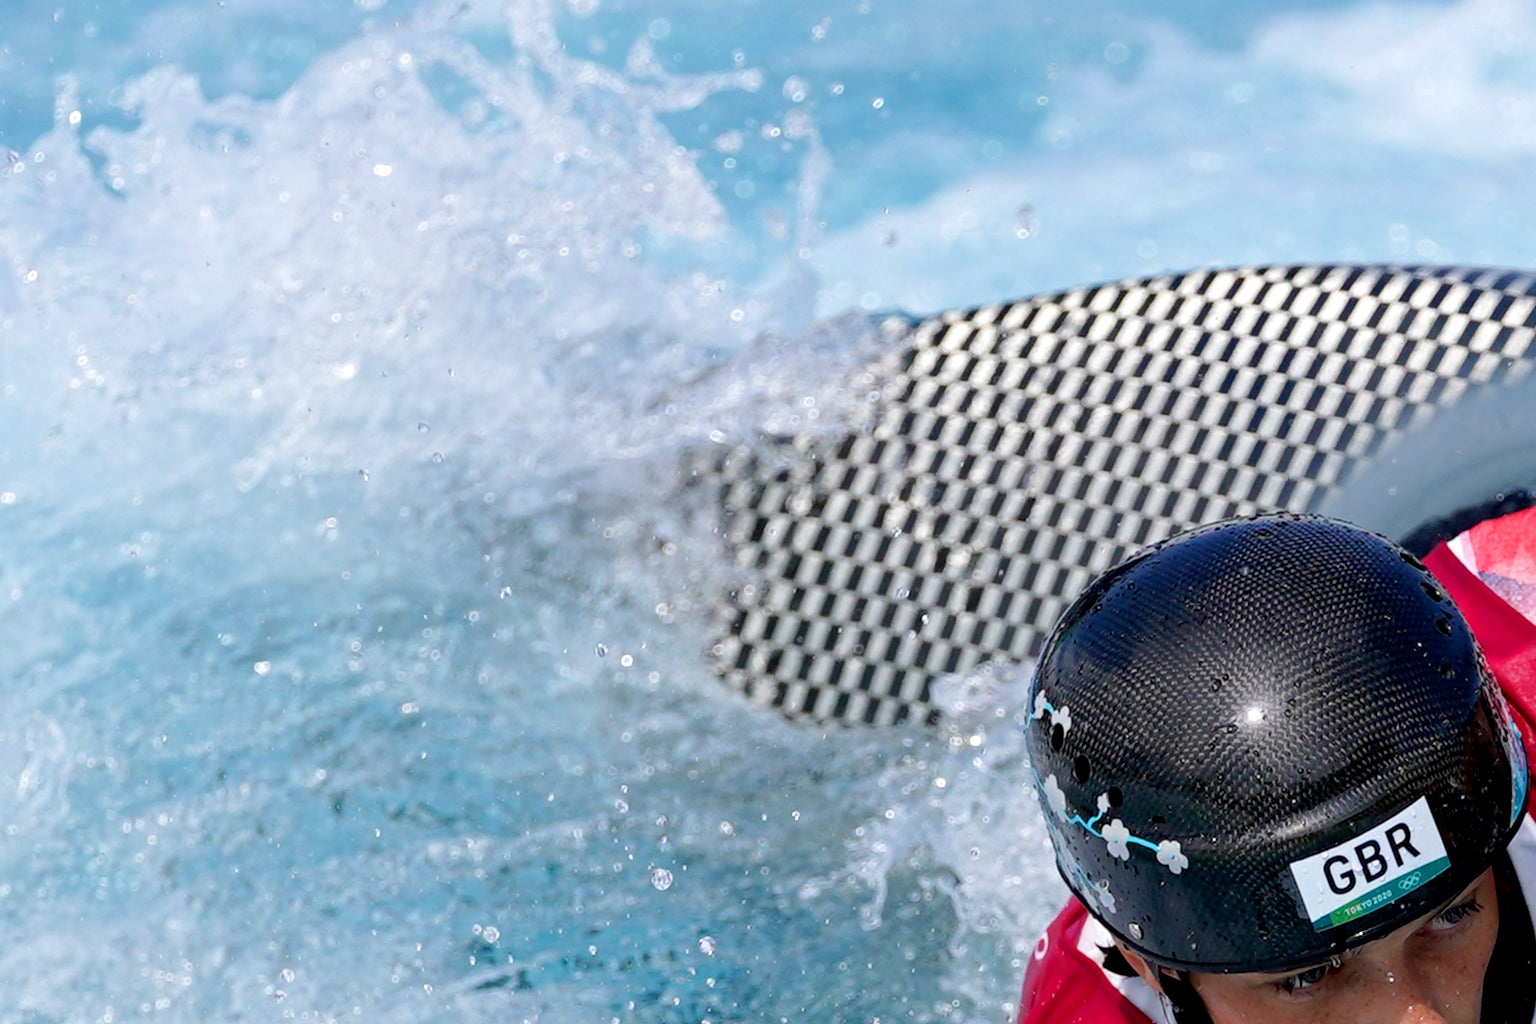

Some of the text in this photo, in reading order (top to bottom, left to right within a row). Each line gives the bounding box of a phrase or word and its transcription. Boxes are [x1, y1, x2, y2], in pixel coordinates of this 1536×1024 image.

[1323, 822, 1421, 895] GBR
[1344, 889, 1393, 916] TOKYO 2020
